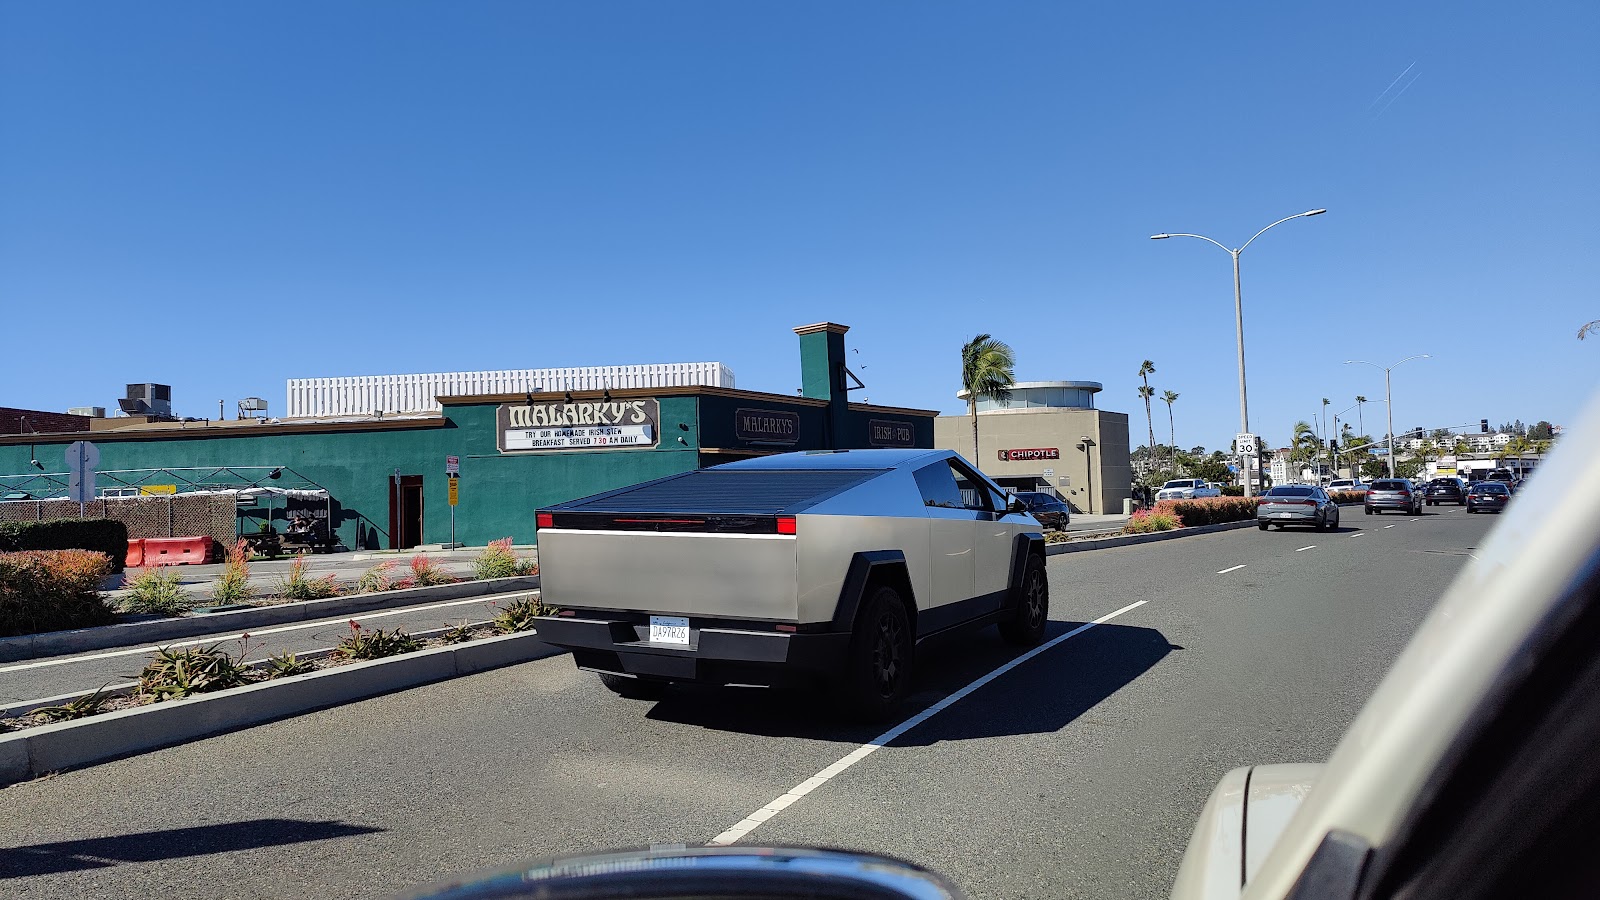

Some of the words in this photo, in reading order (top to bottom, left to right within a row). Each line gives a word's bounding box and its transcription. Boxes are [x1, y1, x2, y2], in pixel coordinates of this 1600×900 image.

[509, 401, 646, 427] MALARKY'S
[743, 416, 793, 434] MALARKY'S
[554, 429, 586, 437] HOMEMADE
[874, 426, 892, 440] IRISH
[897, 428, 910, 441] PUB
[532, 438, 564, 446] BREAKFAST
[569, 438, 591, 446] SERVED
[609, 436, 619, 444] AM
[1240, 444, 1252, 452] 30
